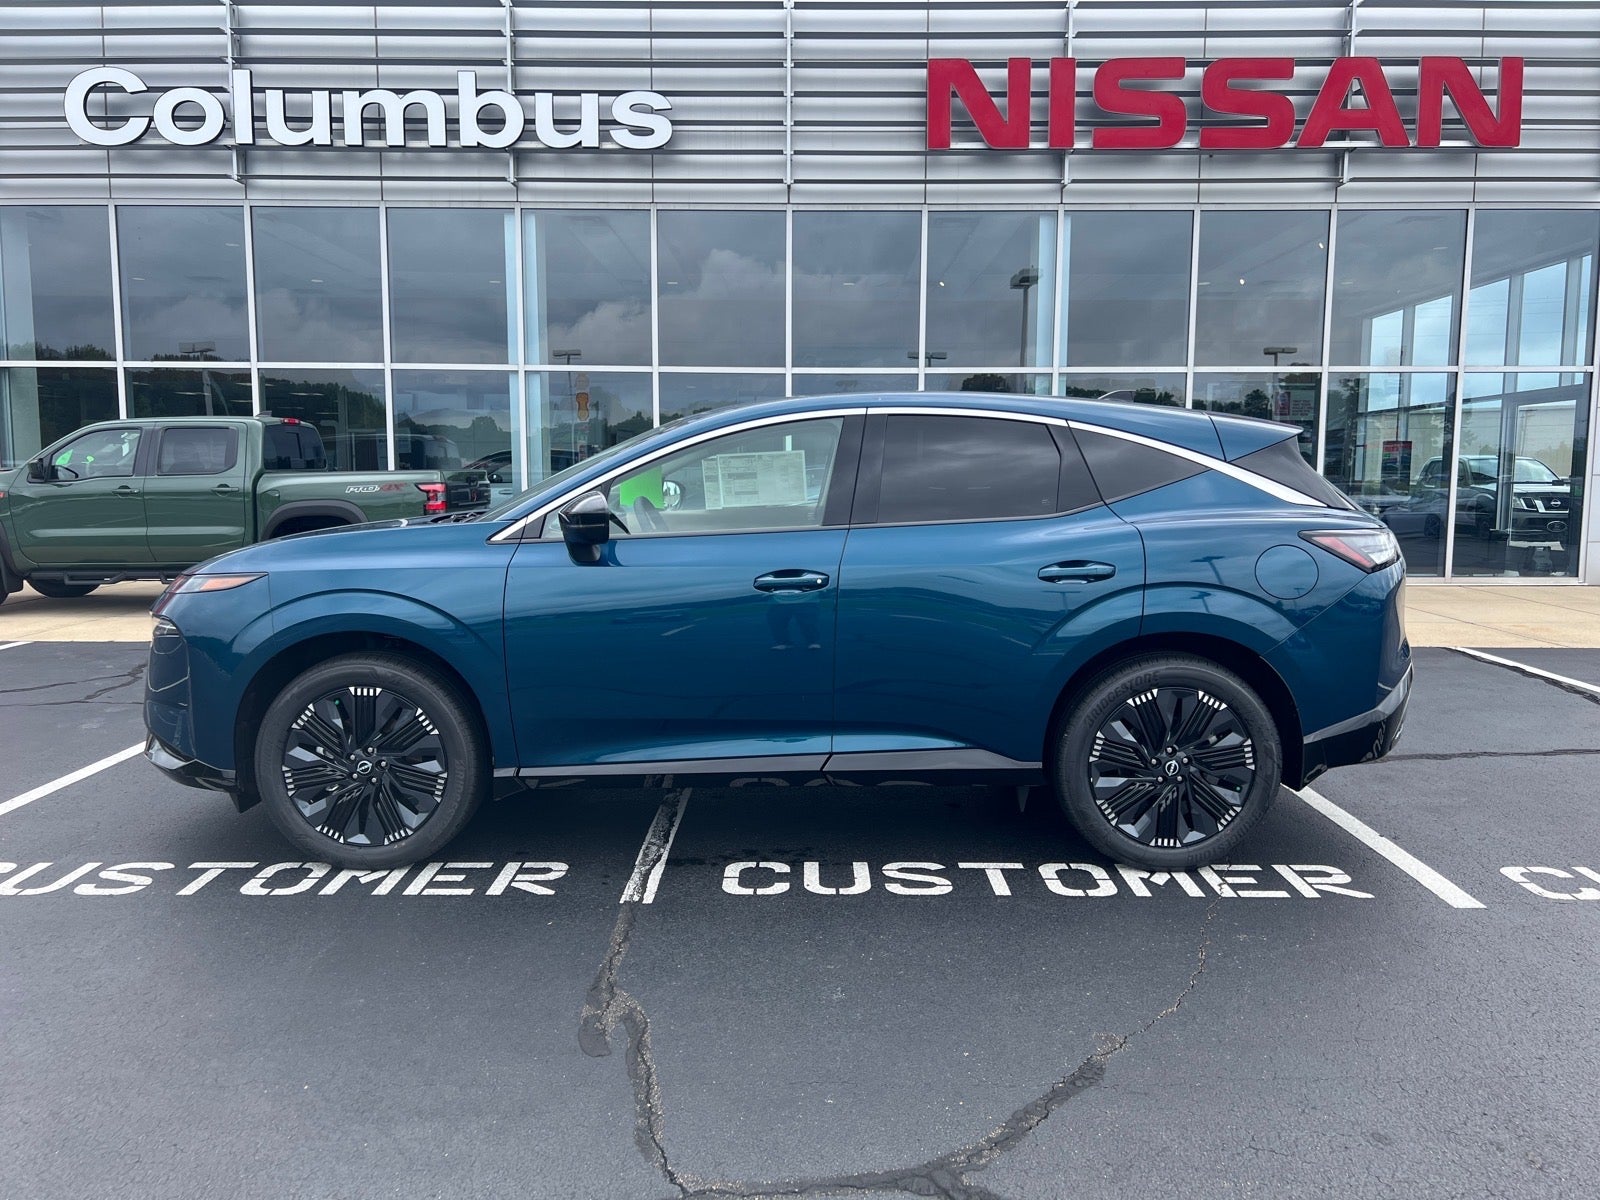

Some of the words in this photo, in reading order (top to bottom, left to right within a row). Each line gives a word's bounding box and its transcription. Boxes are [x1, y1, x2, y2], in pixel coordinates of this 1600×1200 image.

[64, 66, 674, 150] Columbus
[926, 56, 1524, 150] NISSAN
[0, 862, 570, 896] USTOMER
[721, 861, 1374, 898] CUSTOMER
